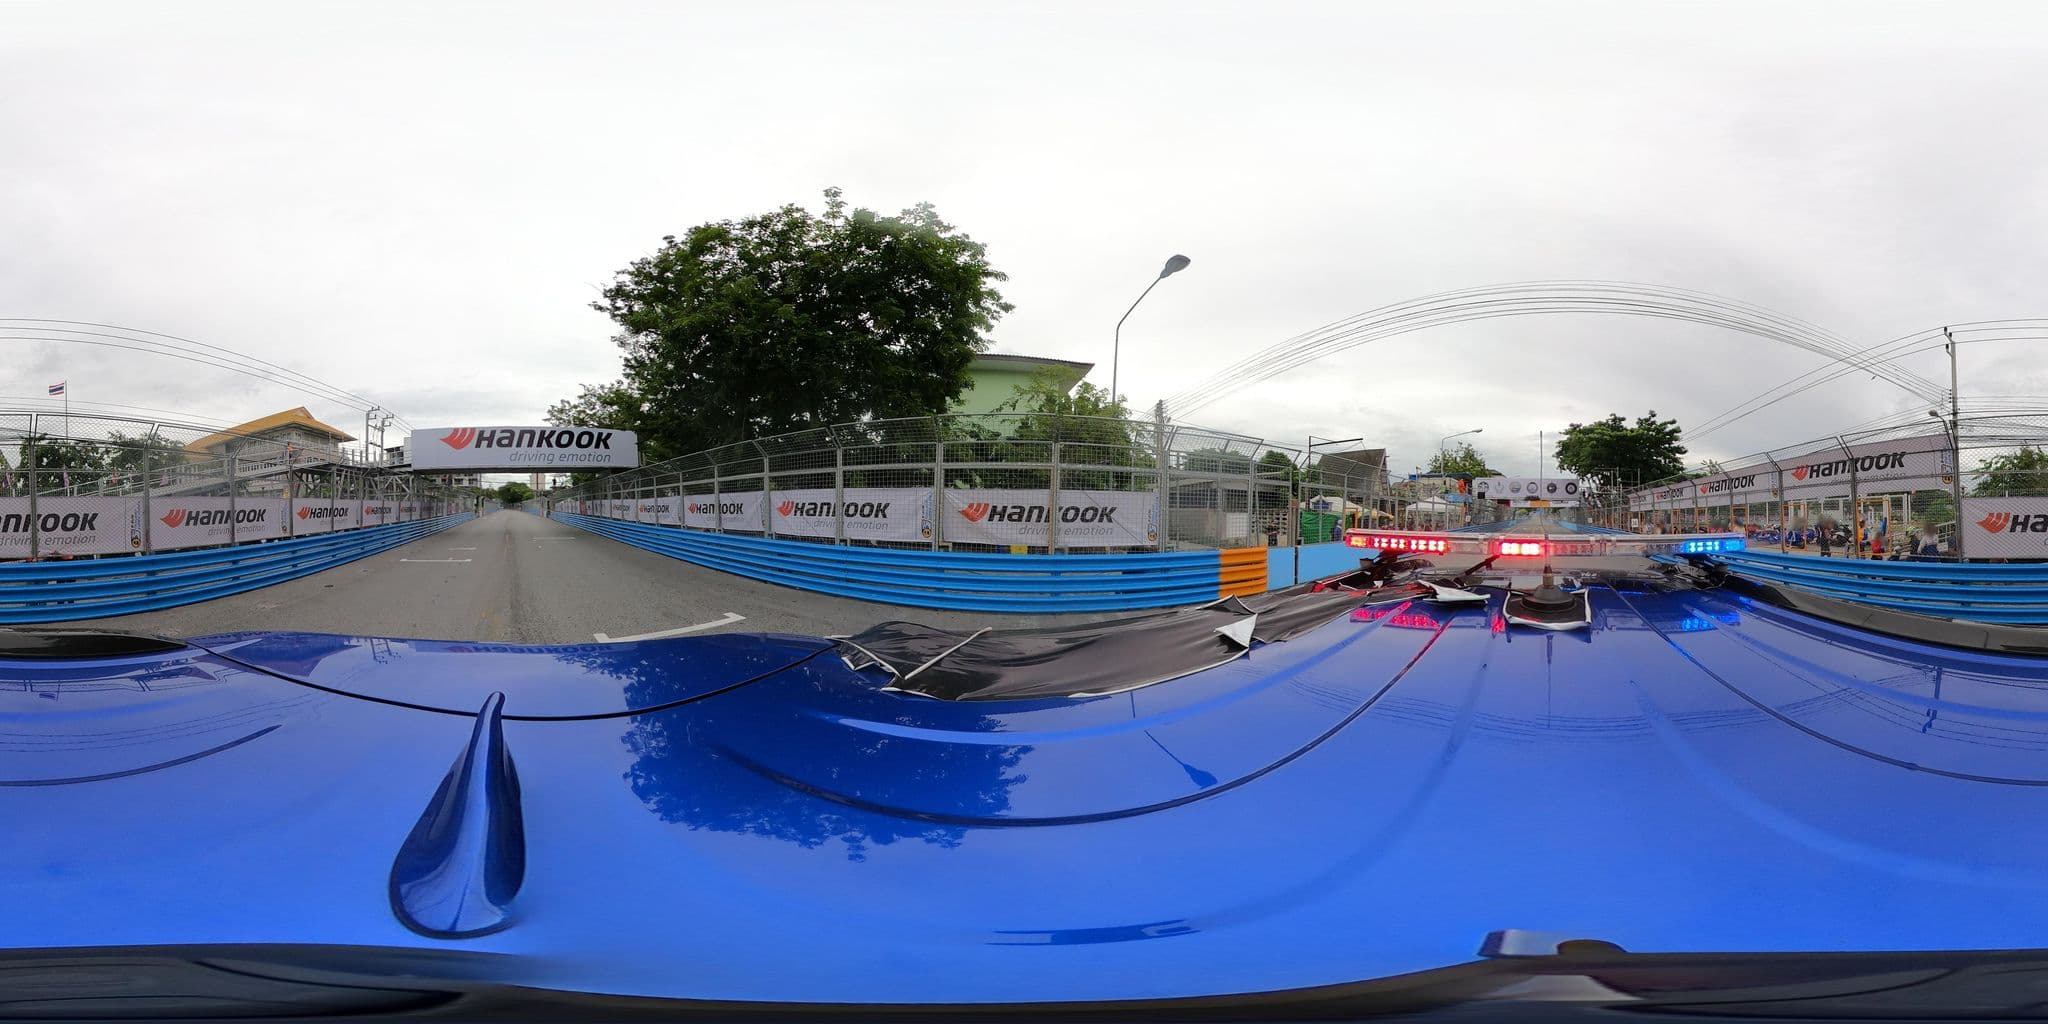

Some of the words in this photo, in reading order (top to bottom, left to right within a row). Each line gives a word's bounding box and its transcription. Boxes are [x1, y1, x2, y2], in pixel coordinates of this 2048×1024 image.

[509, 450, 555, 464] driving
[559, 453, 611, 464] emotion
[1064, 525, 1113, 536] emotion
[44, 534, 96, 546] emotion
